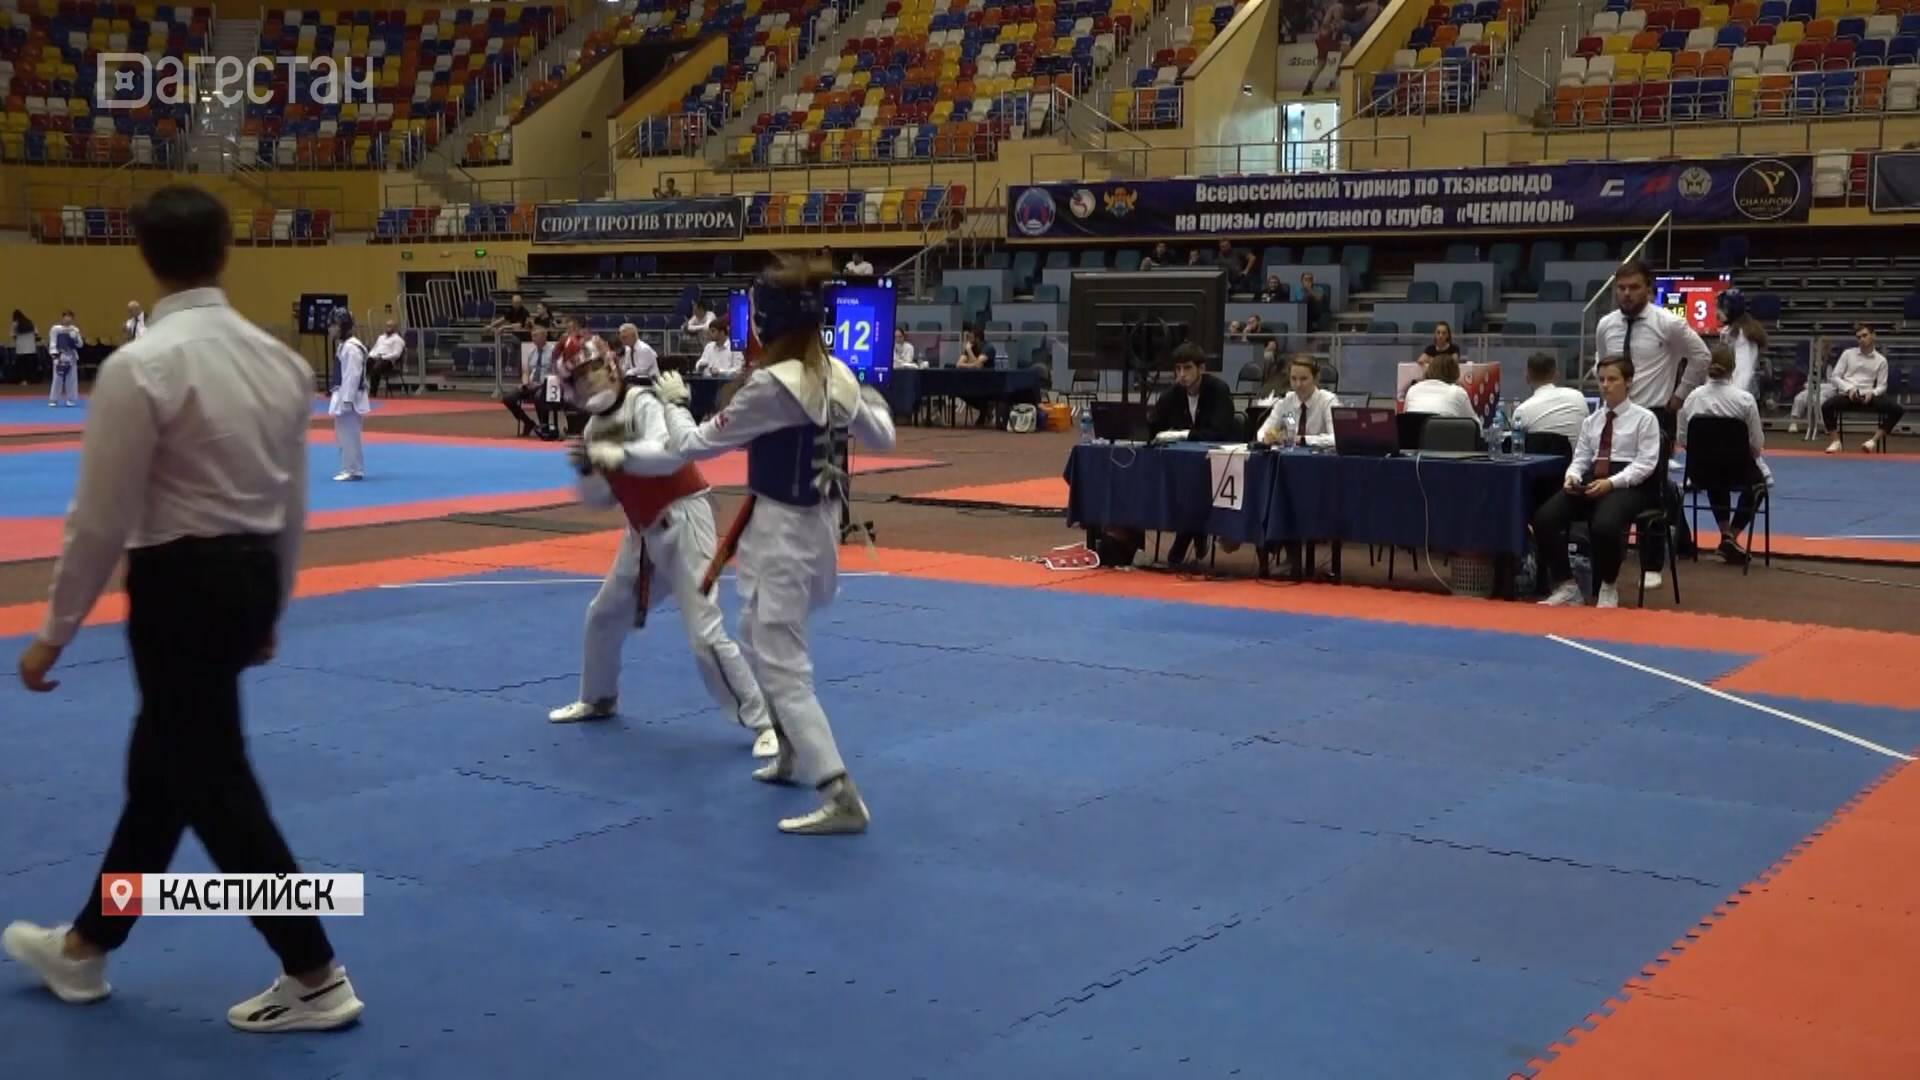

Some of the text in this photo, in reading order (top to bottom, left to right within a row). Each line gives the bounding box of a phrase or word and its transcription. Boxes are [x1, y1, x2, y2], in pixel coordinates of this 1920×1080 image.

[1196, 177, 1339, 204] Всероссийский
[1343, 178, 1410, 199] турнир
[1415, 178, 1438, 196] по
[541, 211, 735, 232] СПОРТ ПРОТИВ ТЕРРОРА
[1175, 200, 1574, 232] на призы спортивного клуба «ЧЕМПИОН»
[1693, 300, 1708, 320] 3
[838, 320, 871, 351] 12
[549, 385, 558, 400] 3
[1220, 475, 1237, 506] 4
